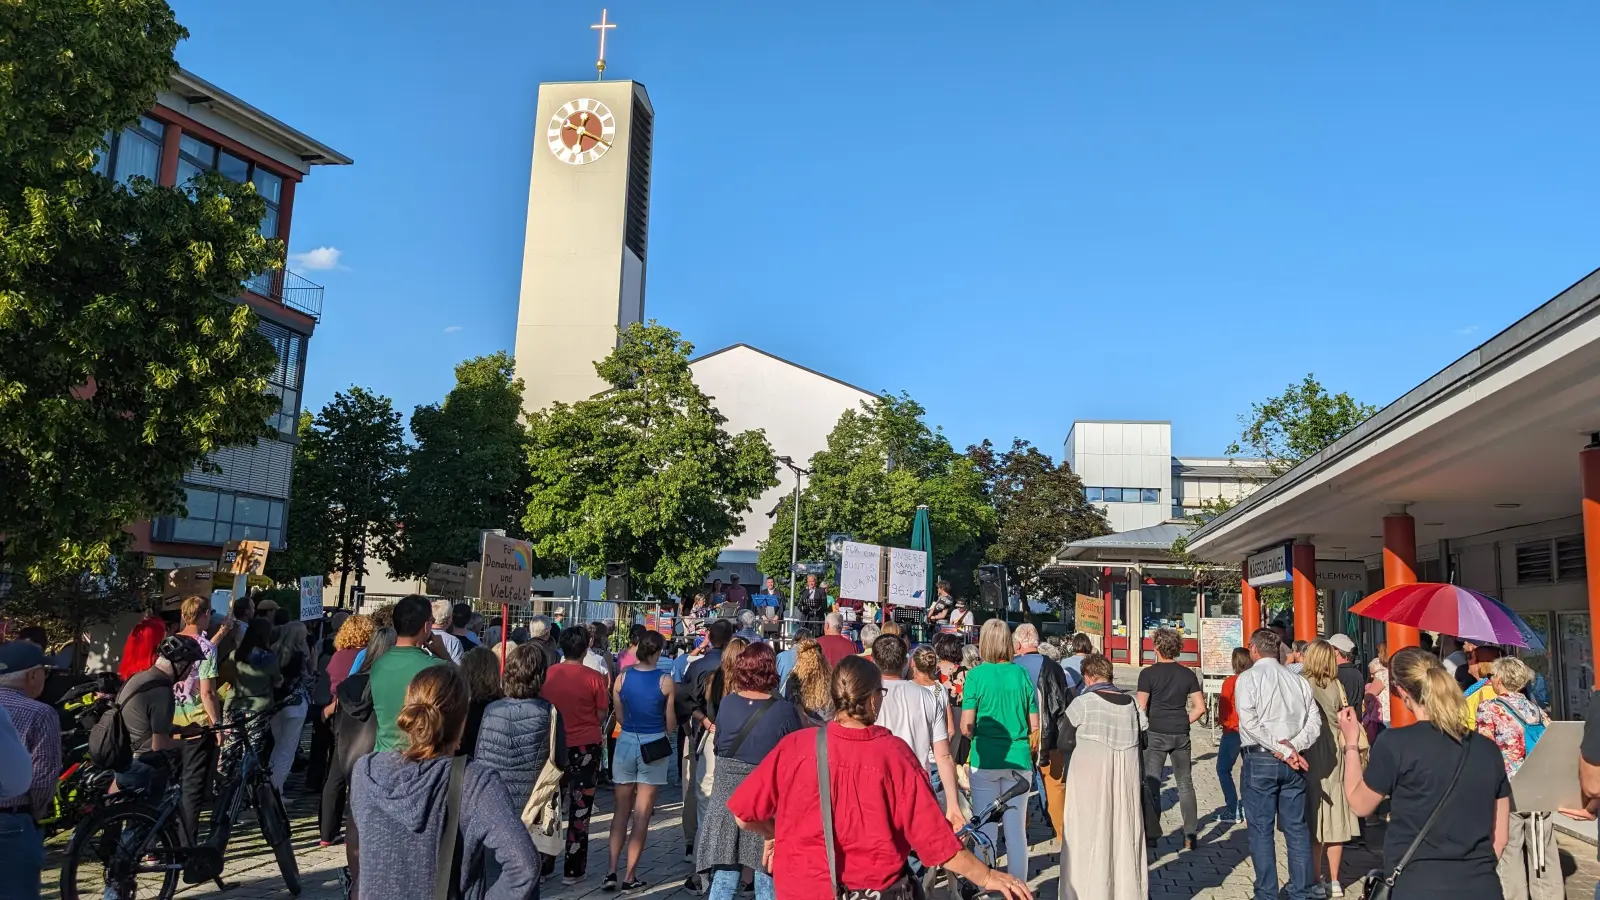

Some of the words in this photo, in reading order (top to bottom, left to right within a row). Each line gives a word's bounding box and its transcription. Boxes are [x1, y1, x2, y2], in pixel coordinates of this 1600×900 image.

[503, 544, 515, 554] Für
[845, 545, 860, 554] FÜR
[893, 551, 923, 563] UNSERE
[485, 553, 522, 571] Demokratie
[501, 574, 513, 583] und
[1316, 572, 1362, 581] HLEMMER
